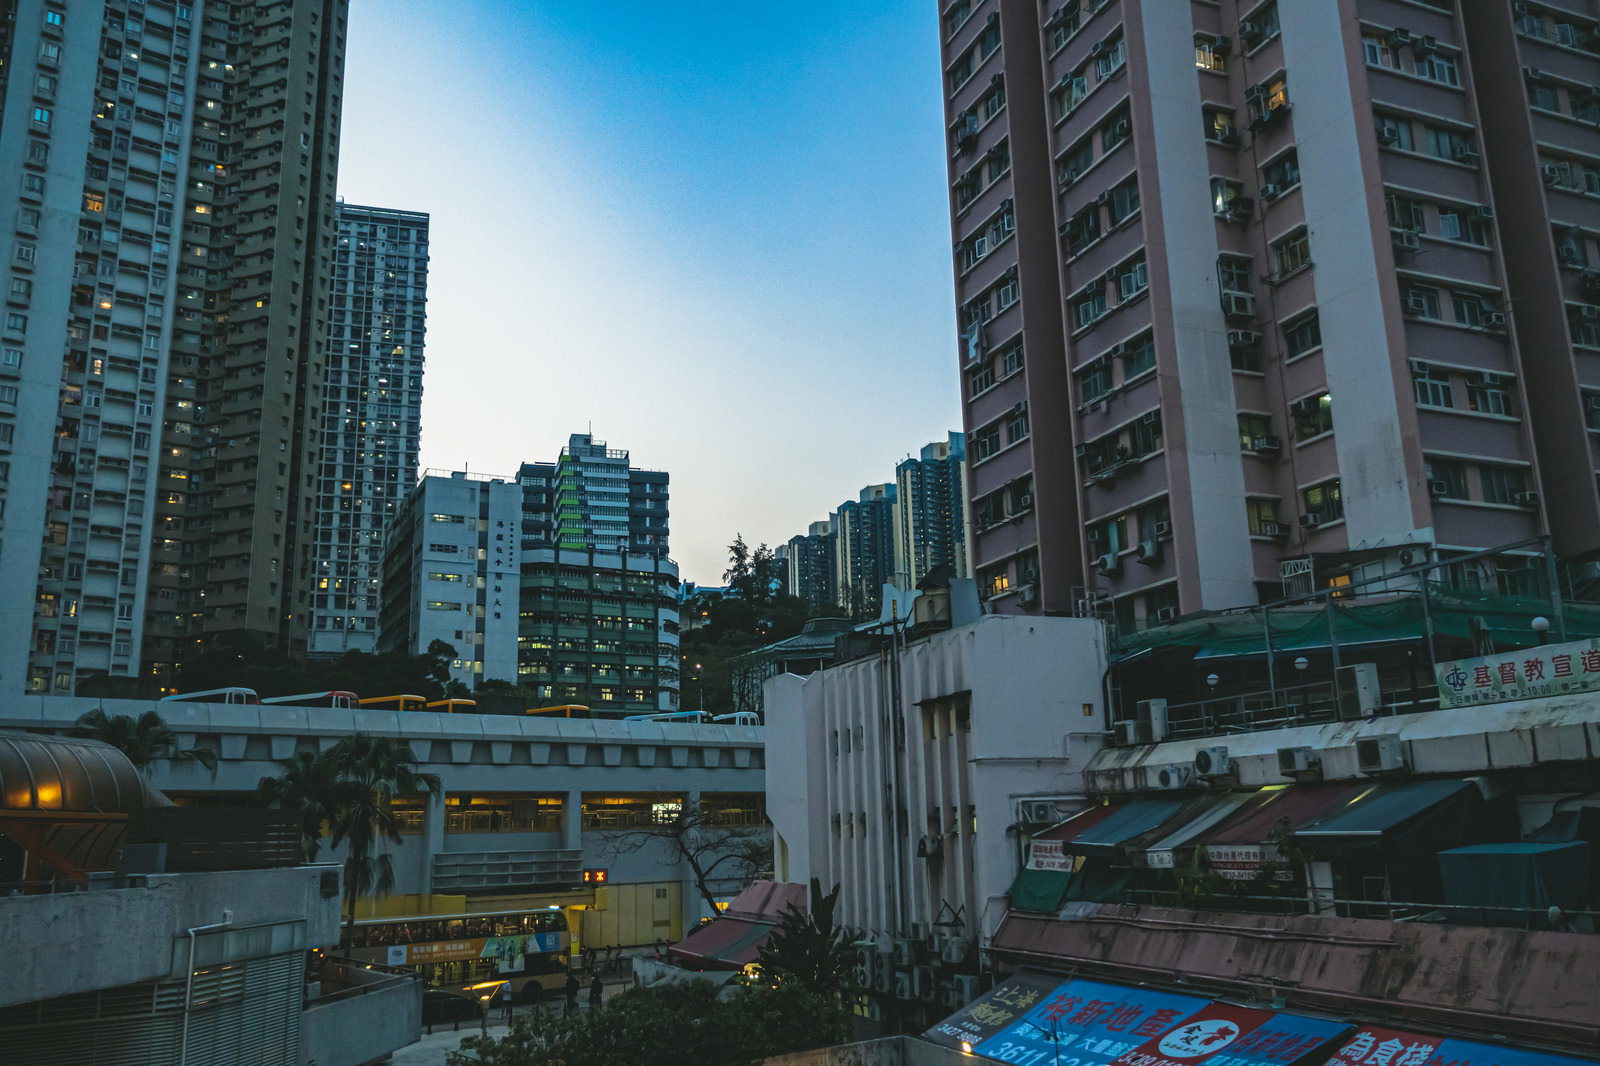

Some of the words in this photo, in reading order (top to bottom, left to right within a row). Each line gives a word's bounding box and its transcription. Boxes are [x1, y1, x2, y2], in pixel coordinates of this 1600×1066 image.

[1473, 649, 1600, 688] 基督教宣道
